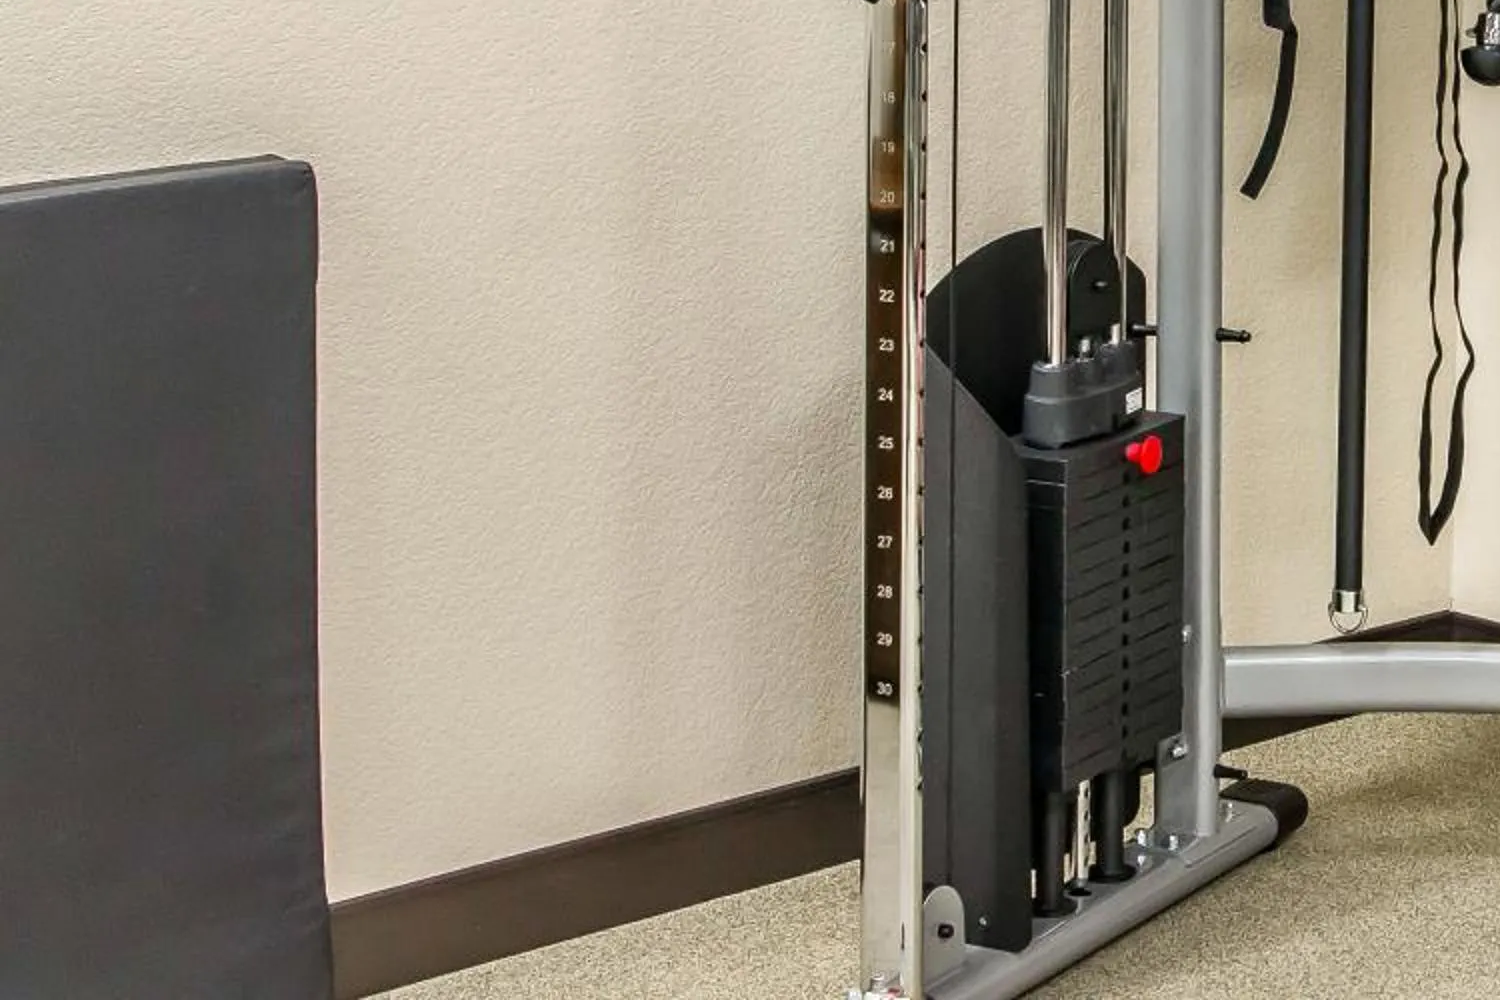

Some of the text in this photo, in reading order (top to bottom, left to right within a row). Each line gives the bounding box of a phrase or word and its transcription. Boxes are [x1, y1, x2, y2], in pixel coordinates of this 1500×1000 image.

[880, 190, 895, 204] 20
[880, 239, 895, 253] 21
[879, 289, 895, 302] 22
[879, 338, 894, 351] 23
[878, 388, 894, 401] 24
[878, 436, 894, 449] 25
[877, 535, 893, 548] 27
[877, 584, 893, 598] 28
[876, 632, 893, 646] 29
[876, 681, 893, 696] 30
